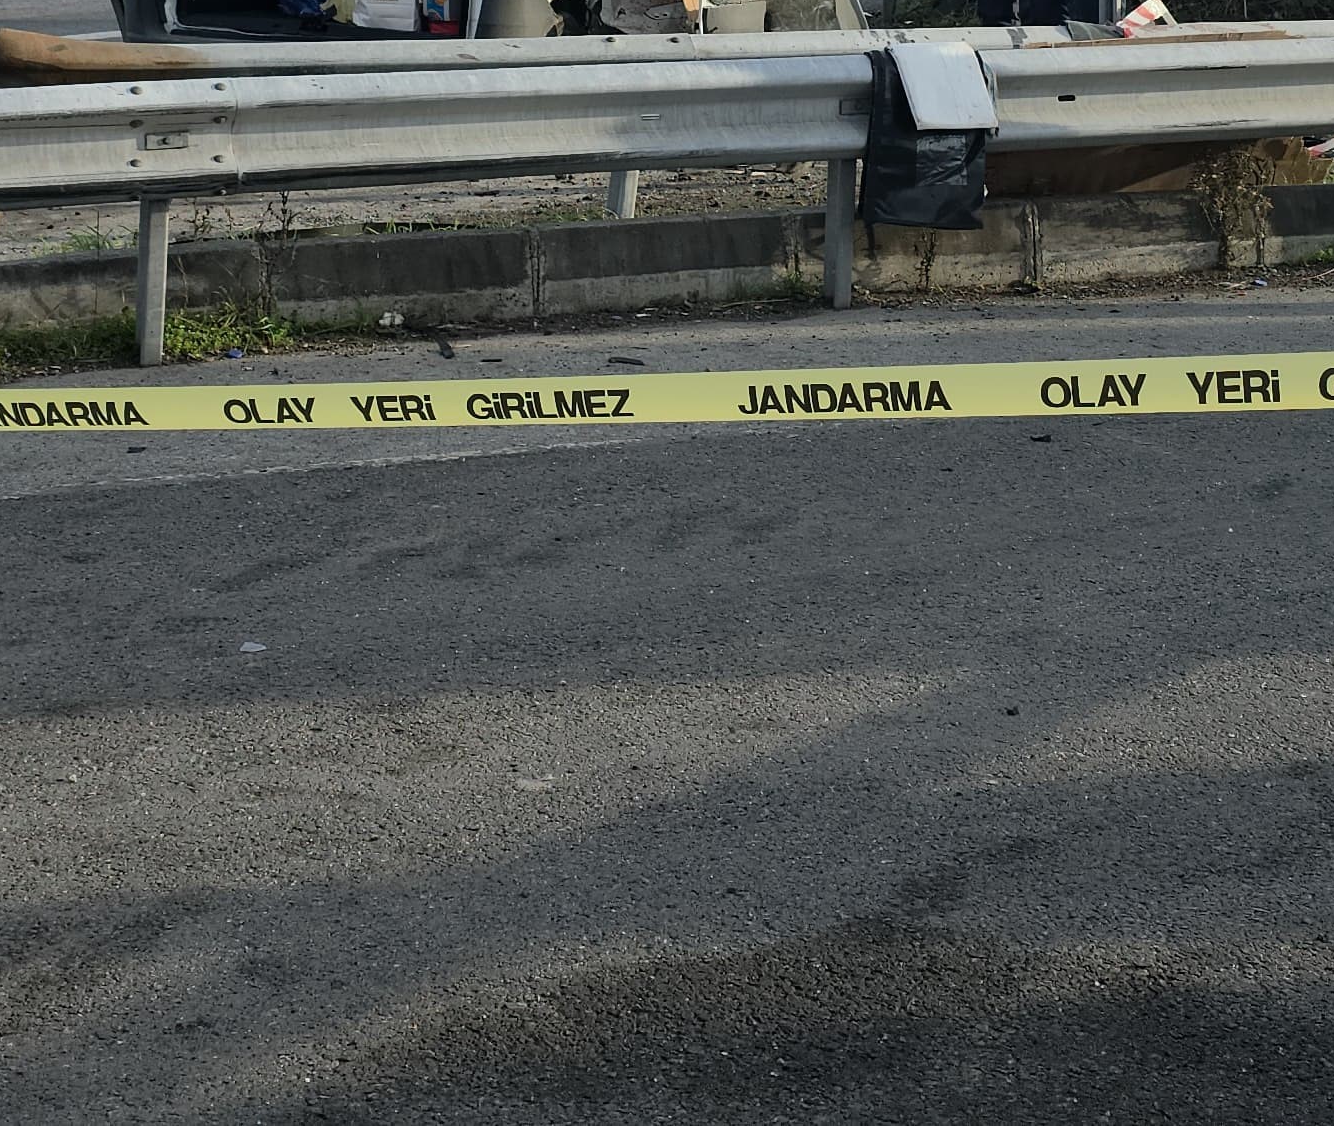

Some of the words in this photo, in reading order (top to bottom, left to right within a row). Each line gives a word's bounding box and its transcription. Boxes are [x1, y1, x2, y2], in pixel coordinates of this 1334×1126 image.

[223, 397, 316, 425] OLAY
[737, 380, 953, 415] JANDARMA
[1040, 373, 1147, 410] OLAY
